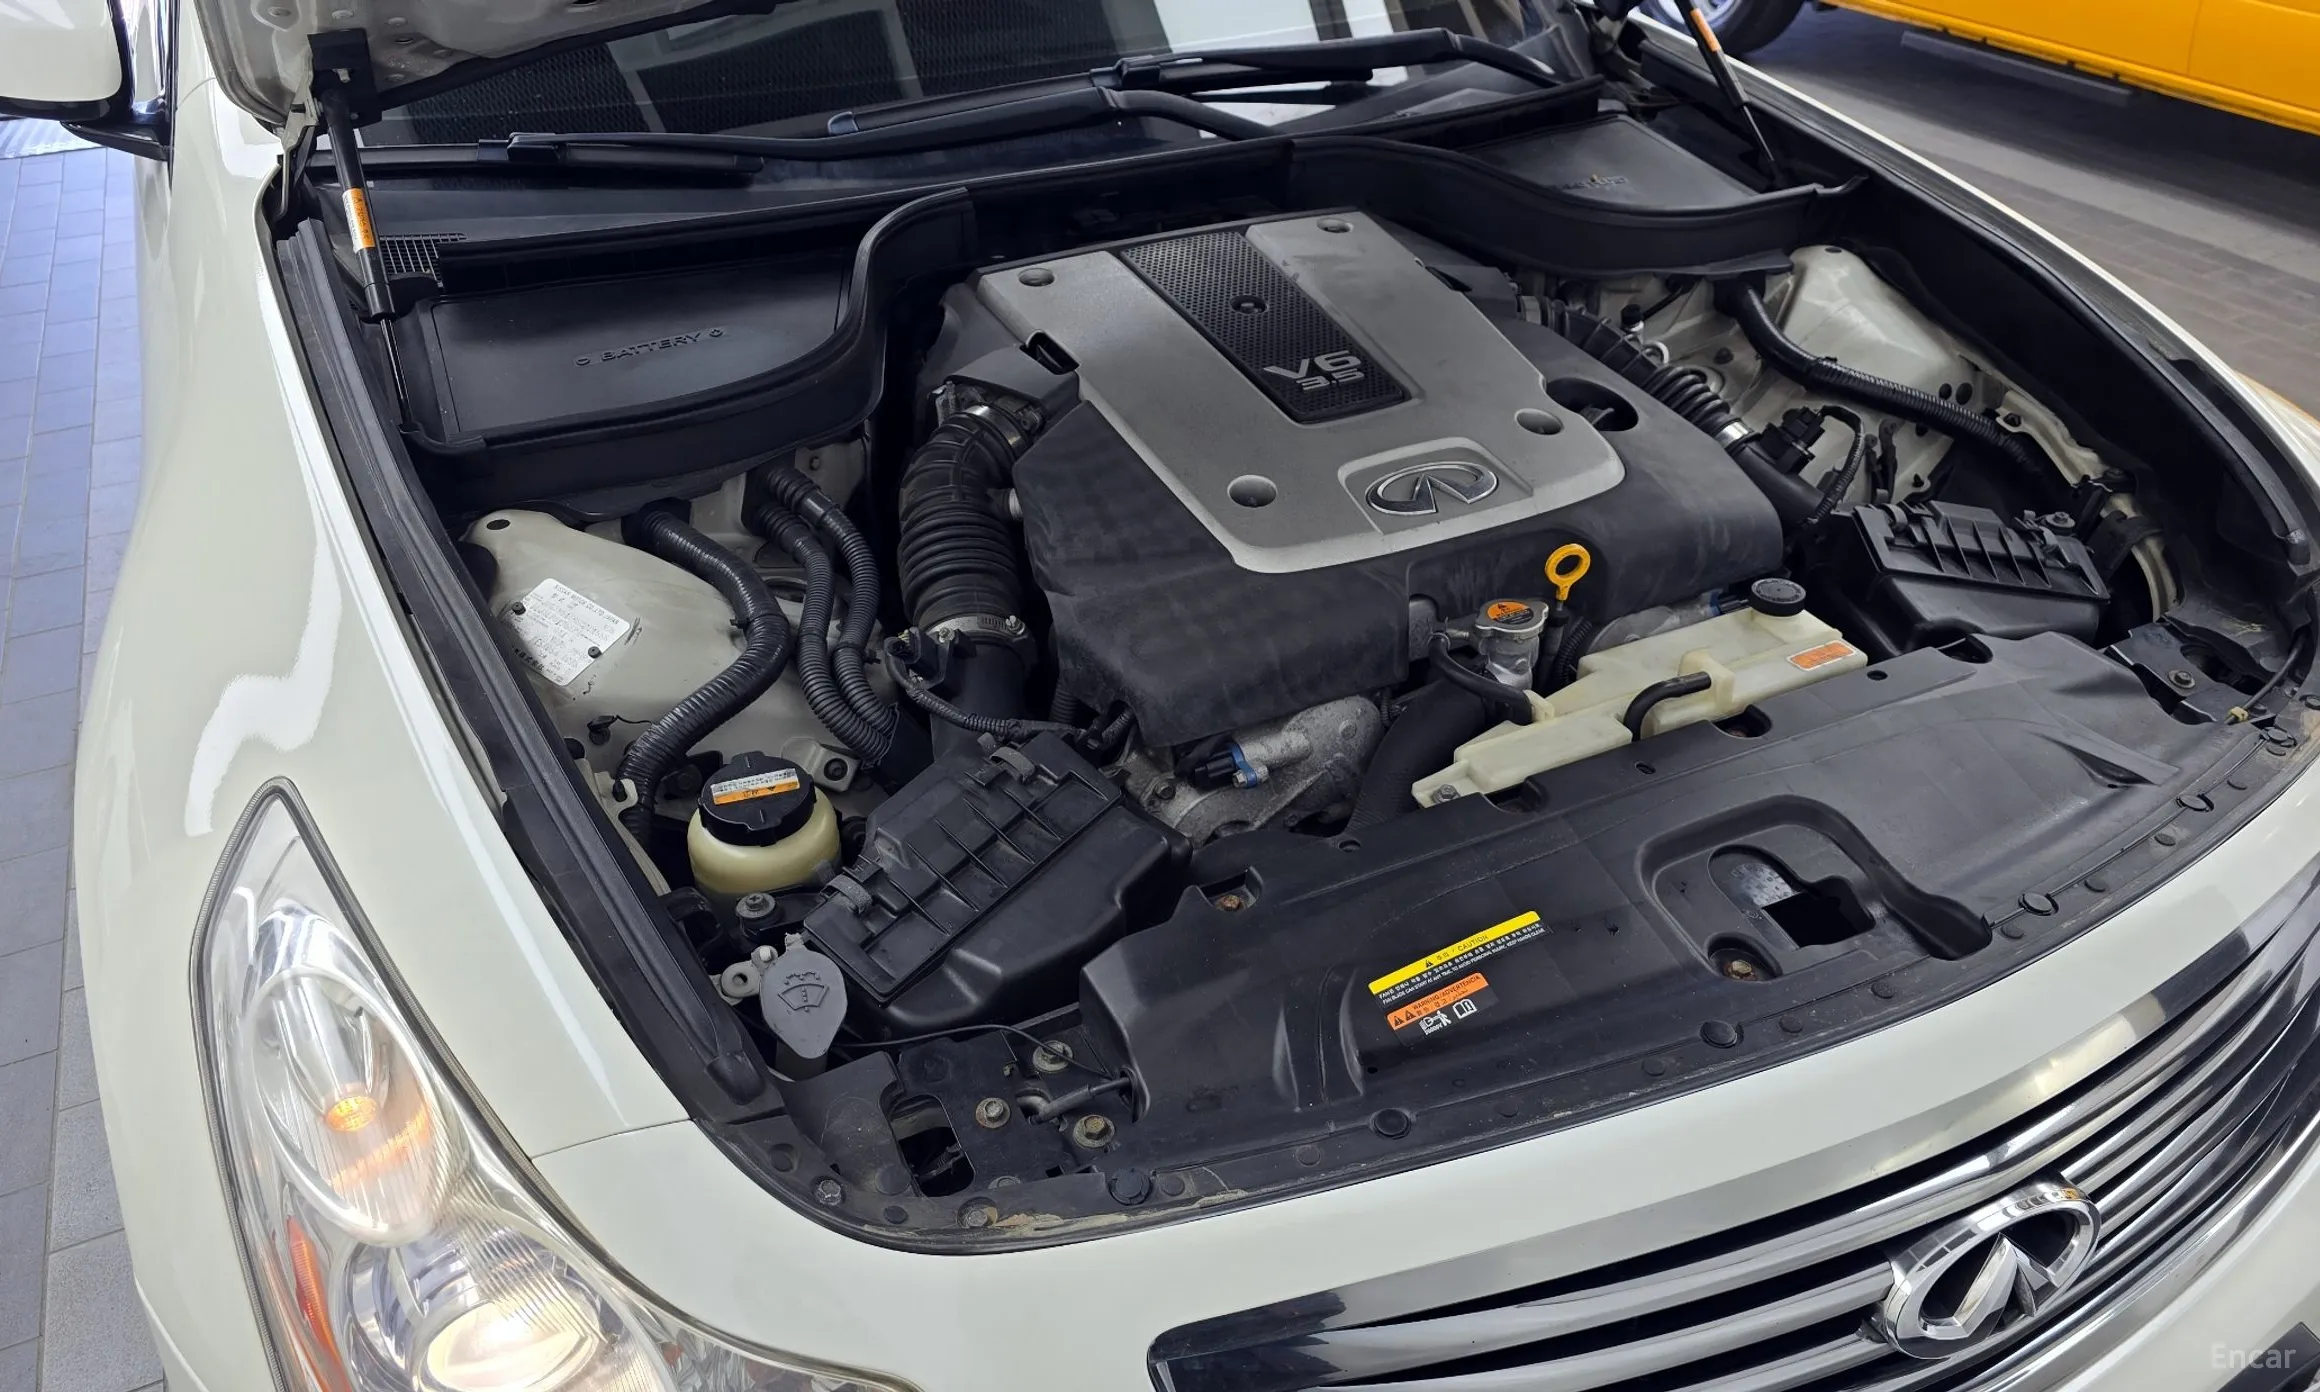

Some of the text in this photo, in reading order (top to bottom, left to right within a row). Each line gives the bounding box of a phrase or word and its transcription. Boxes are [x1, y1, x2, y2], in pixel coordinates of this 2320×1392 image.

[602, 332, 701, 362] BATTERY
[1263, 350, 1362, 379] V6
[1295, 368, 1365, 391] 3.5
[1457, 935, 1488, 951] CAUTION
